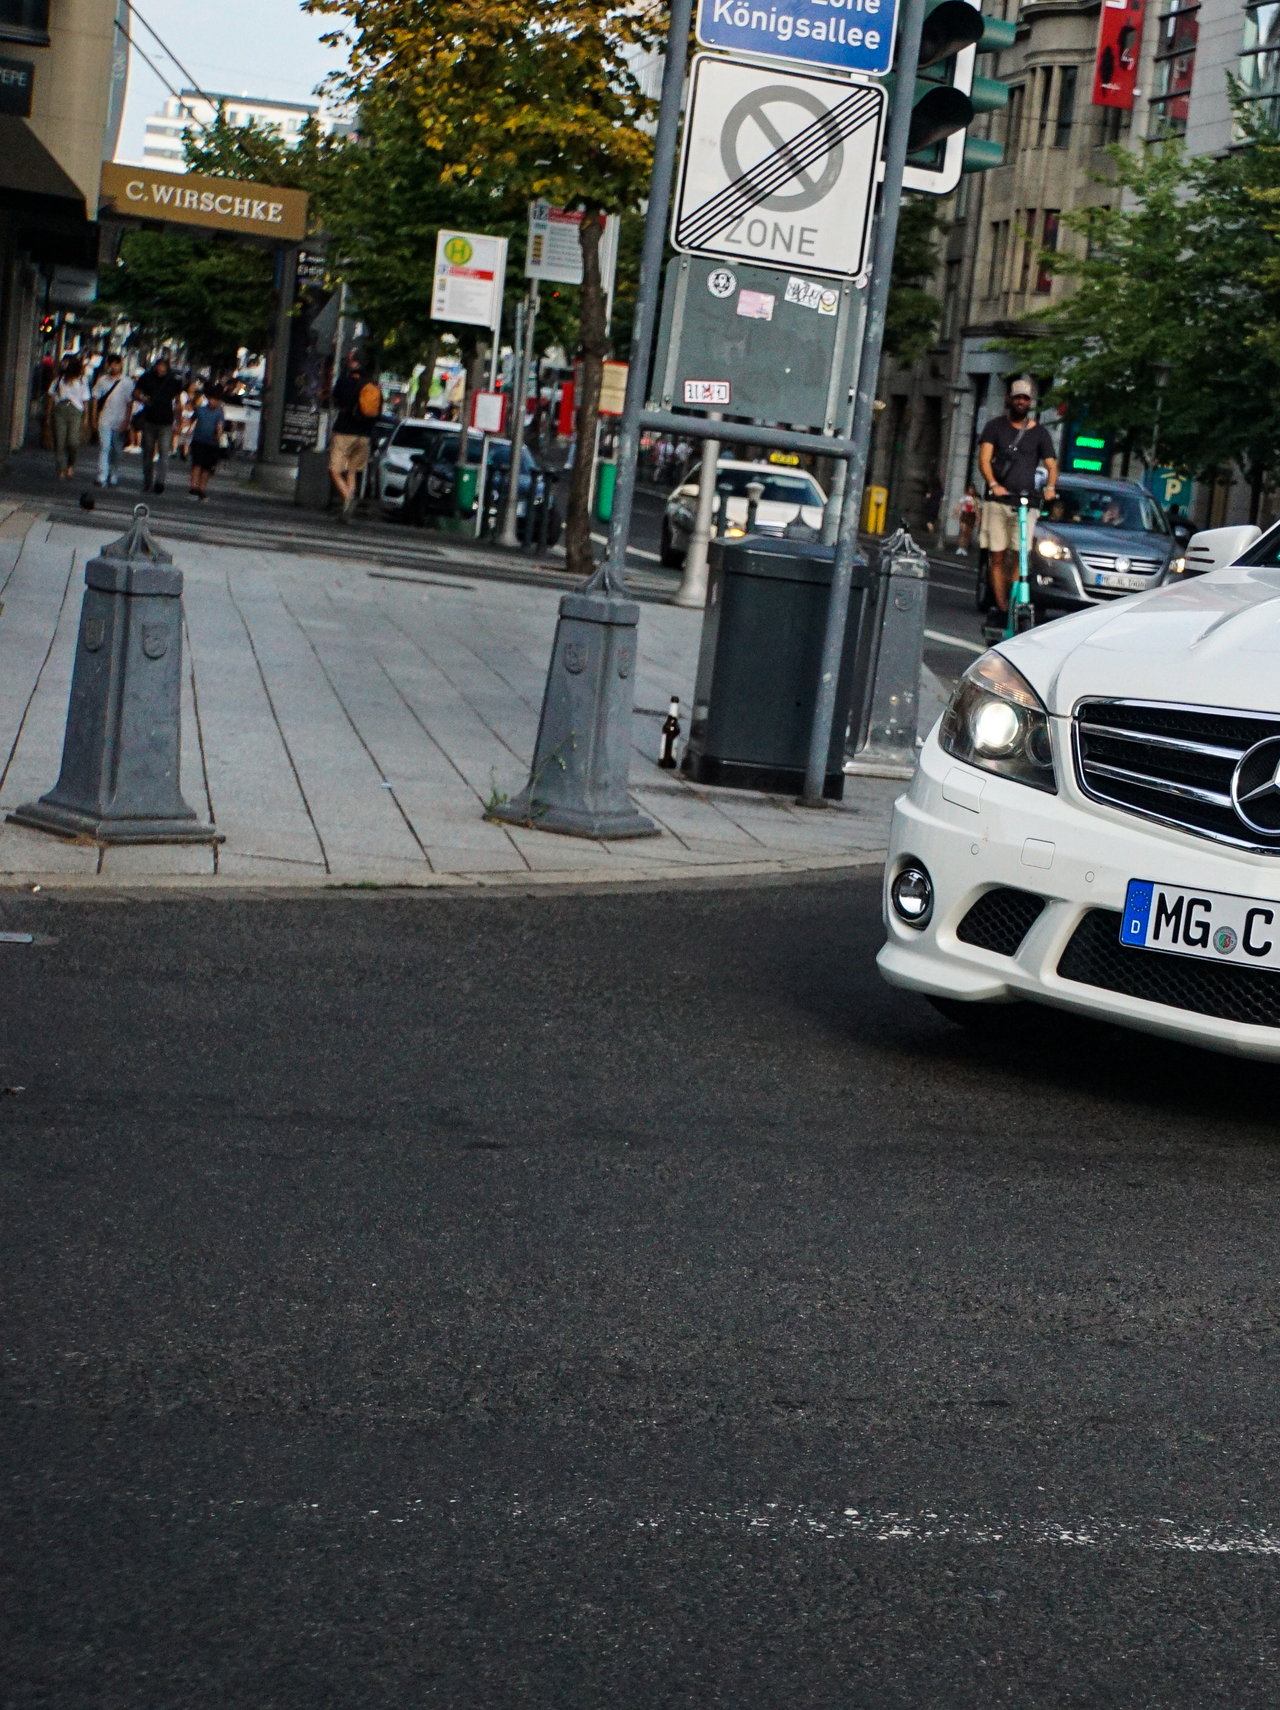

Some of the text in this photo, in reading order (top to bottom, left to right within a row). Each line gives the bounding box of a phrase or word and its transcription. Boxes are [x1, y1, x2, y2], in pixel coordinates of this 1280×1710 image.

[713, 0, 881, 49] Königsallee
[724, 214, 818, 257] ZONE
[1164, 478, 1182, 501] P
[1130, 920, 1141, 934] D
[1153, 892, 1212, 949] MG
[1242, 908, 1274, 957] C
